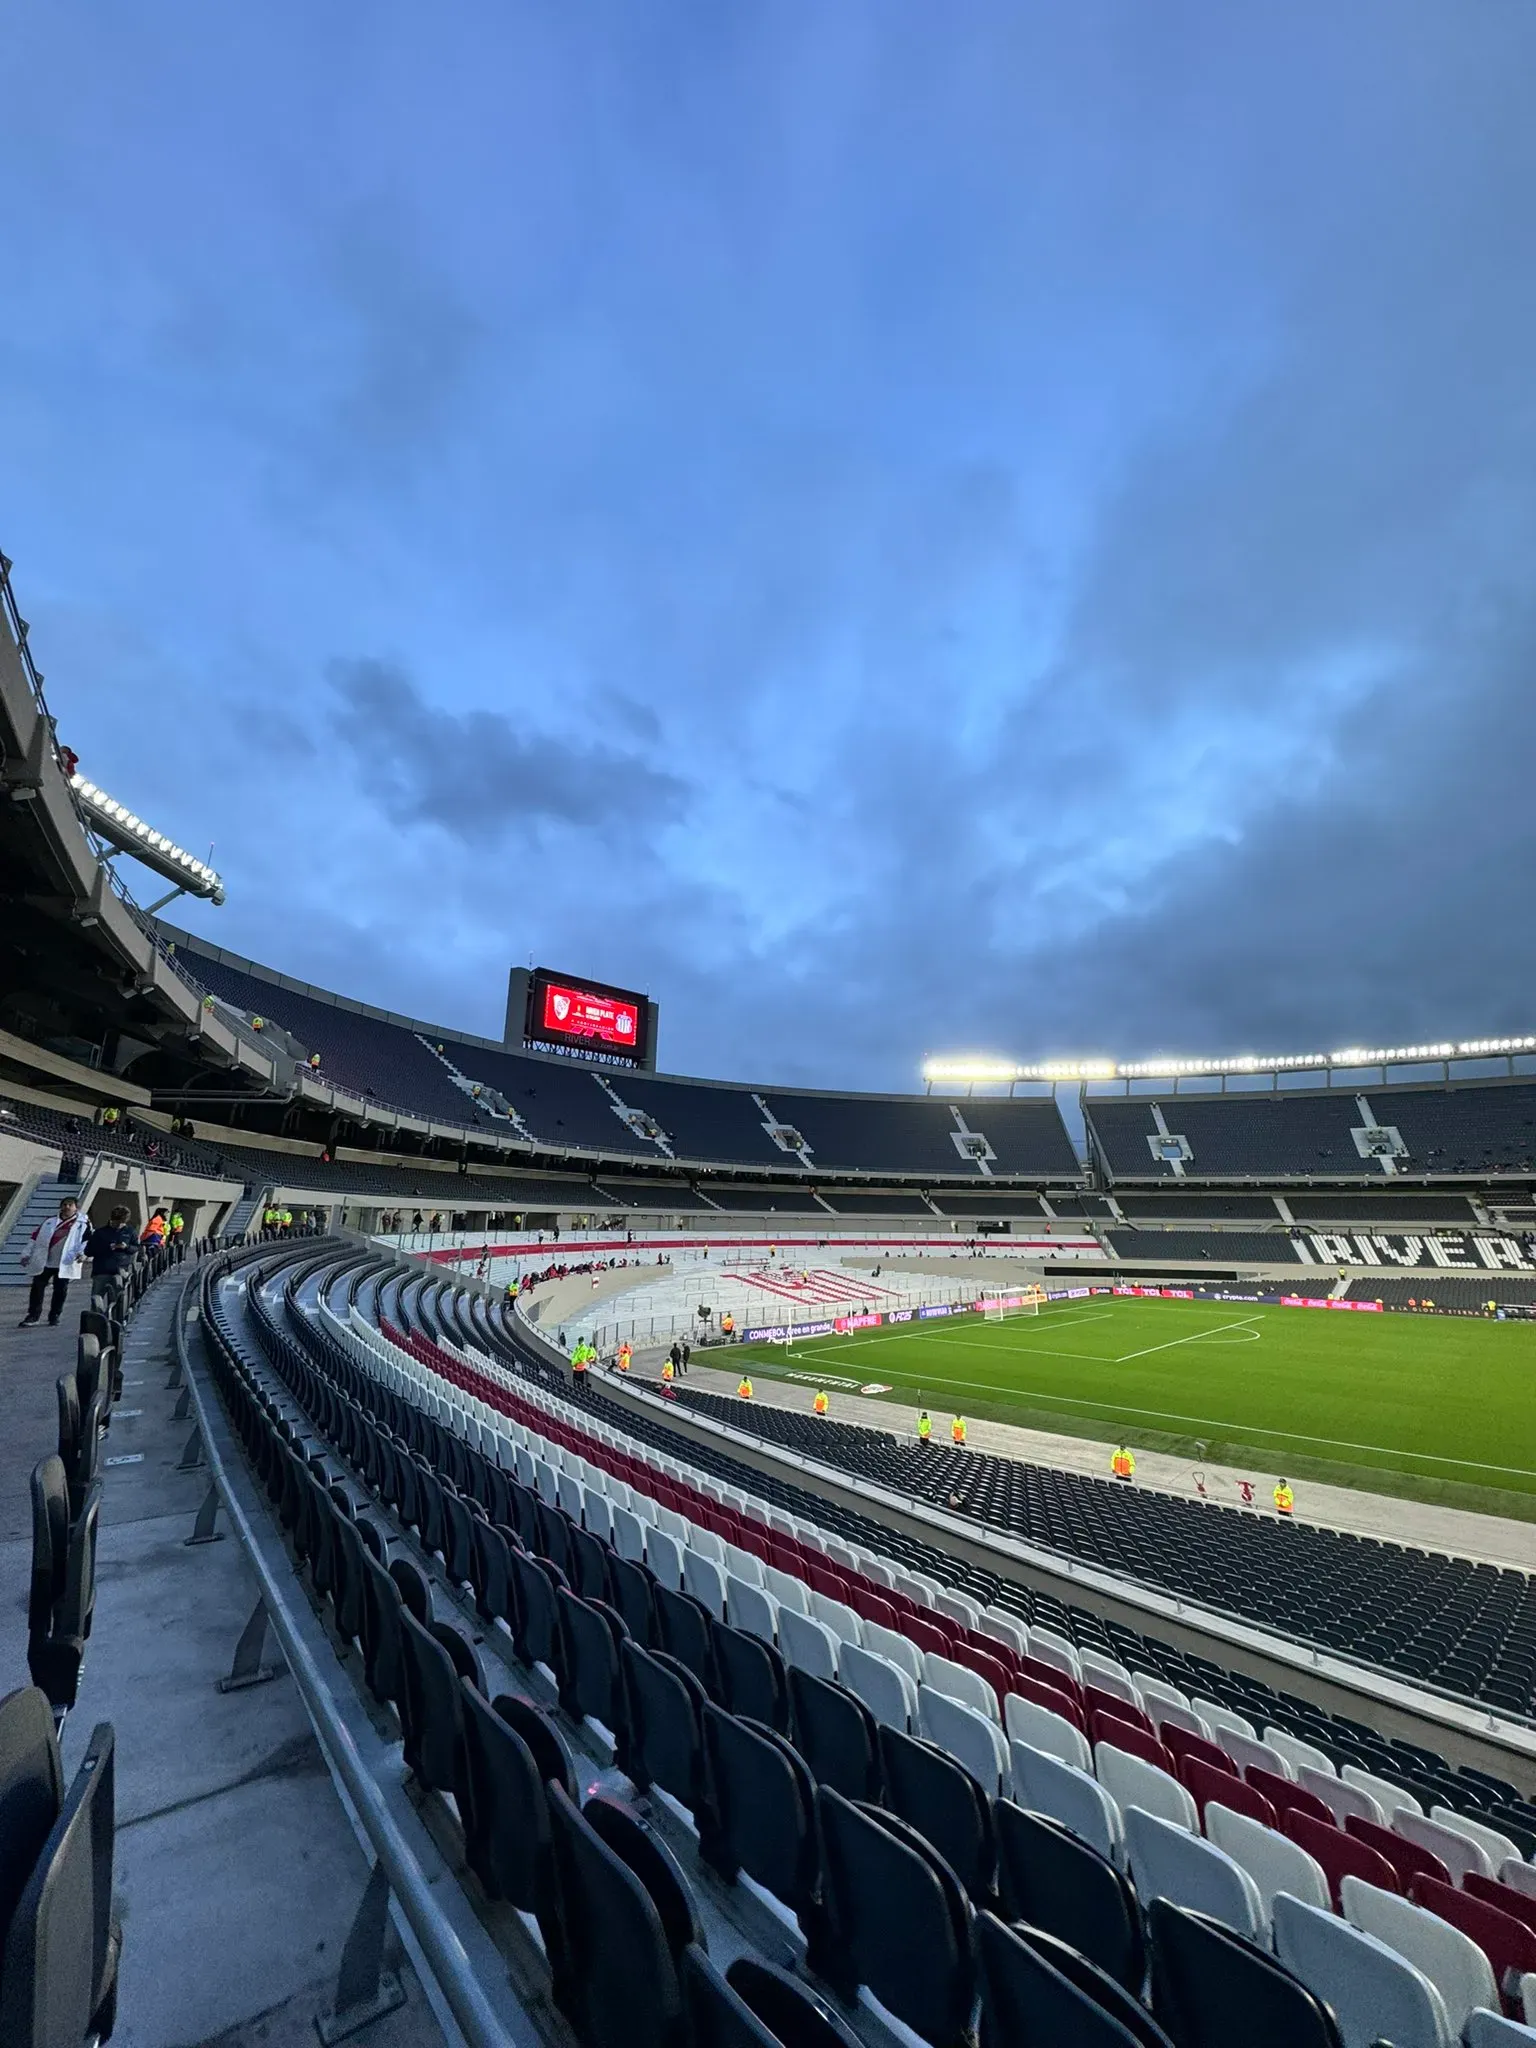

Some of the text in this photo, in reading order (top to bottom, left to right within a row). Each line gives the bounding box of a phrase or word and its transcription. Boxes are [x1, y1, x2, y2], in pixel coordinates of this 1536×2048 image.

[1309, 1234, 1536, 1270] RIVER
[1116, 1287, 1135, 1295] TCL
[1171, 1290, 1189, 1298] TCL
[1222, 1293, 1259, 1302] crypto.com
[847, 1315, 877, 1328] MAPFRE
[749, 1328, 785, 1340] CONMEBOL
[811, 1323, 831, 1334] grande
